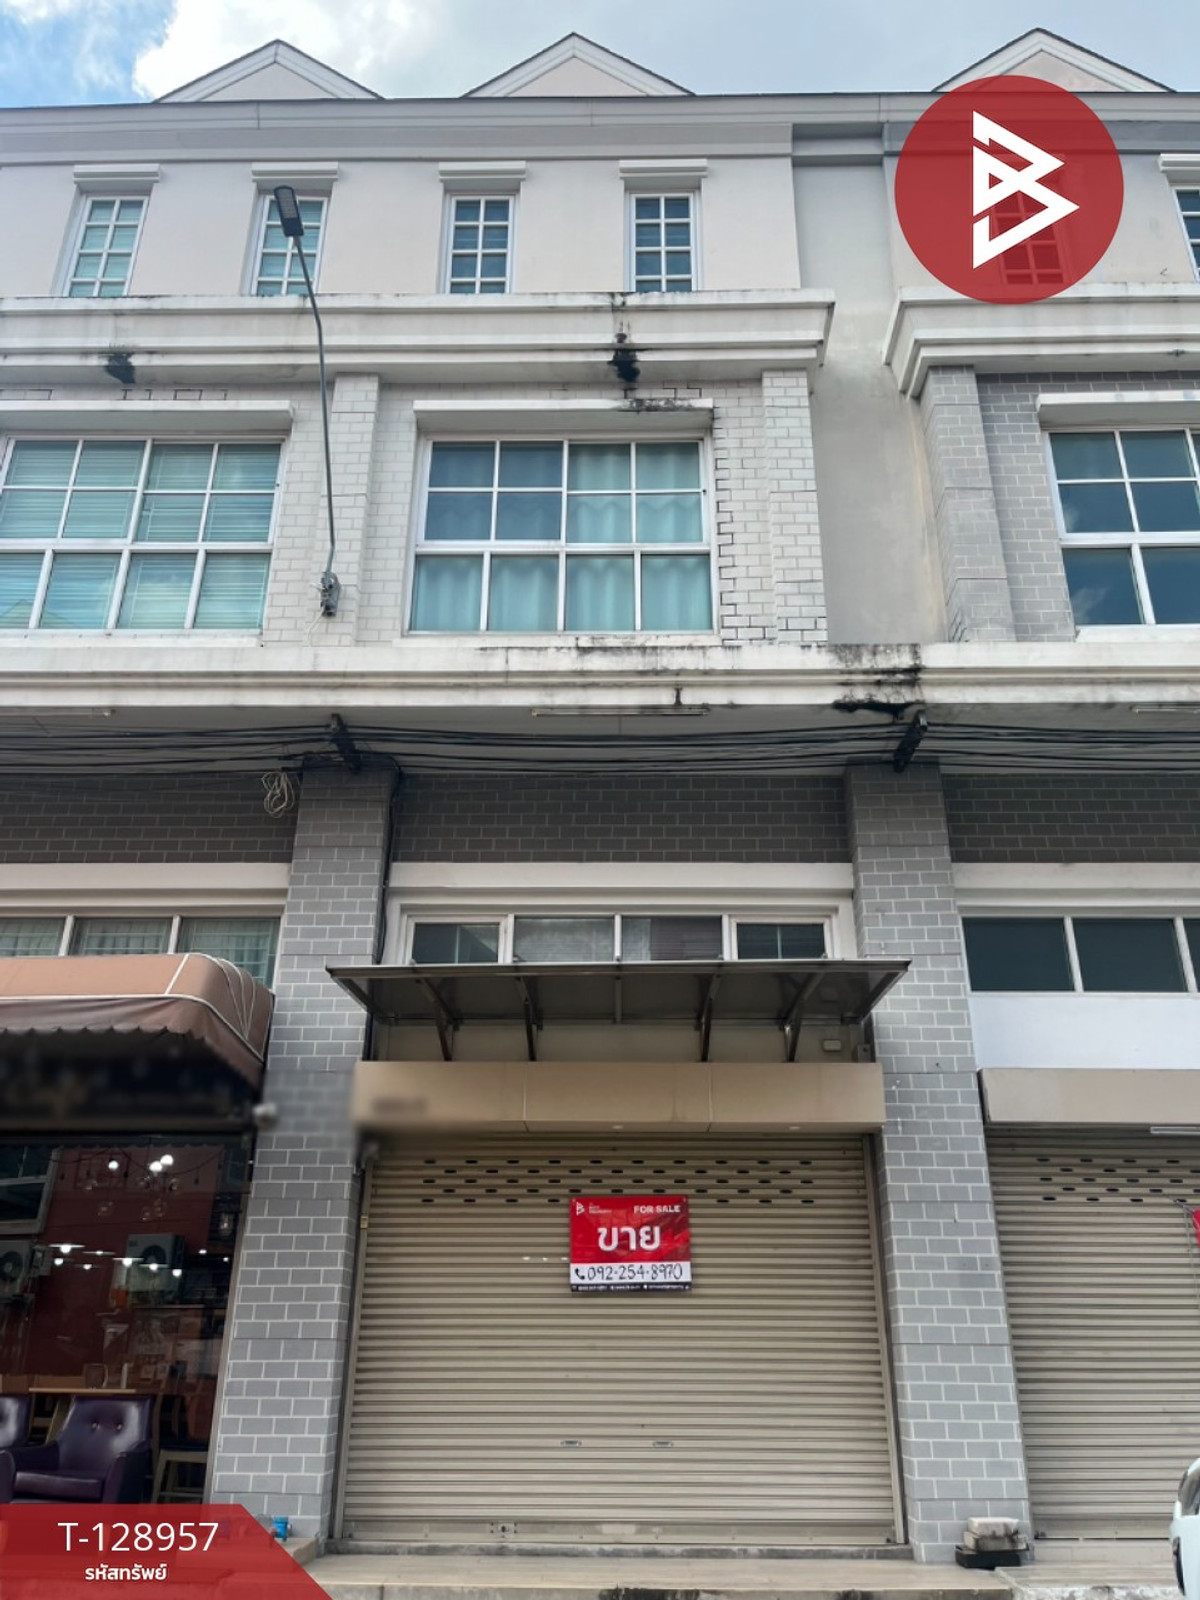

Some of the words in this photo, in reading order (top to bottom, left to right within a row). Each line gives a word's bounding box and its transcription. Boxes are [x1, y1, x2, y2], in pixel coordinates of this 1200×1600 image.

[634, 1205, 653, 1214] FOR
[656, 1204, 681, 1213] SALE
[597, 1225, 661, 1251] ขาย
